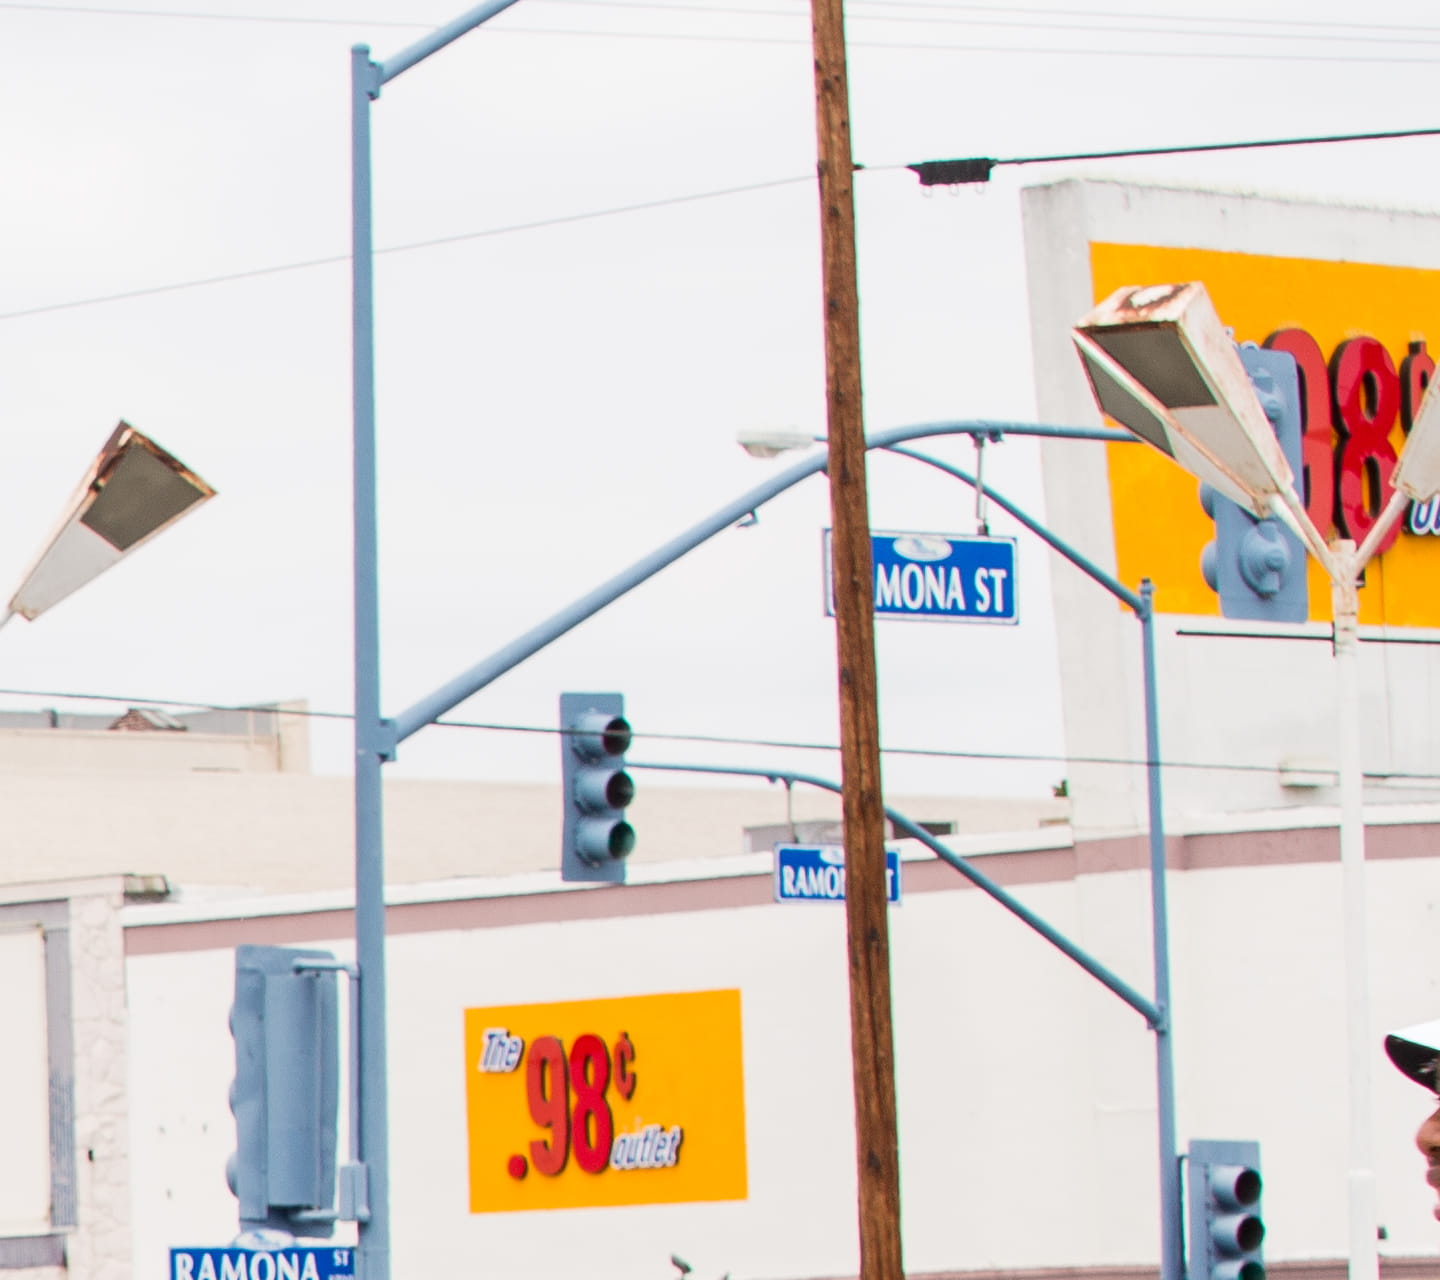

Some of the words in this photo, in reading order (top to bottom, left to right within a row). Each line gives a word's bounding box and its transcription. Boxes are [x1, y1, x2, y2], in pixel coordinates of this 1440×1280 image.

[876, 563, 965, 611] MONA
[975, 568, 1007, 613] ST
[783, 865, 846, 898] RAMO
[478, 1027, 523, 1072] The
[610, 1123, 683, 1170] outlet
[334, 1250, 349, 1266] ST
